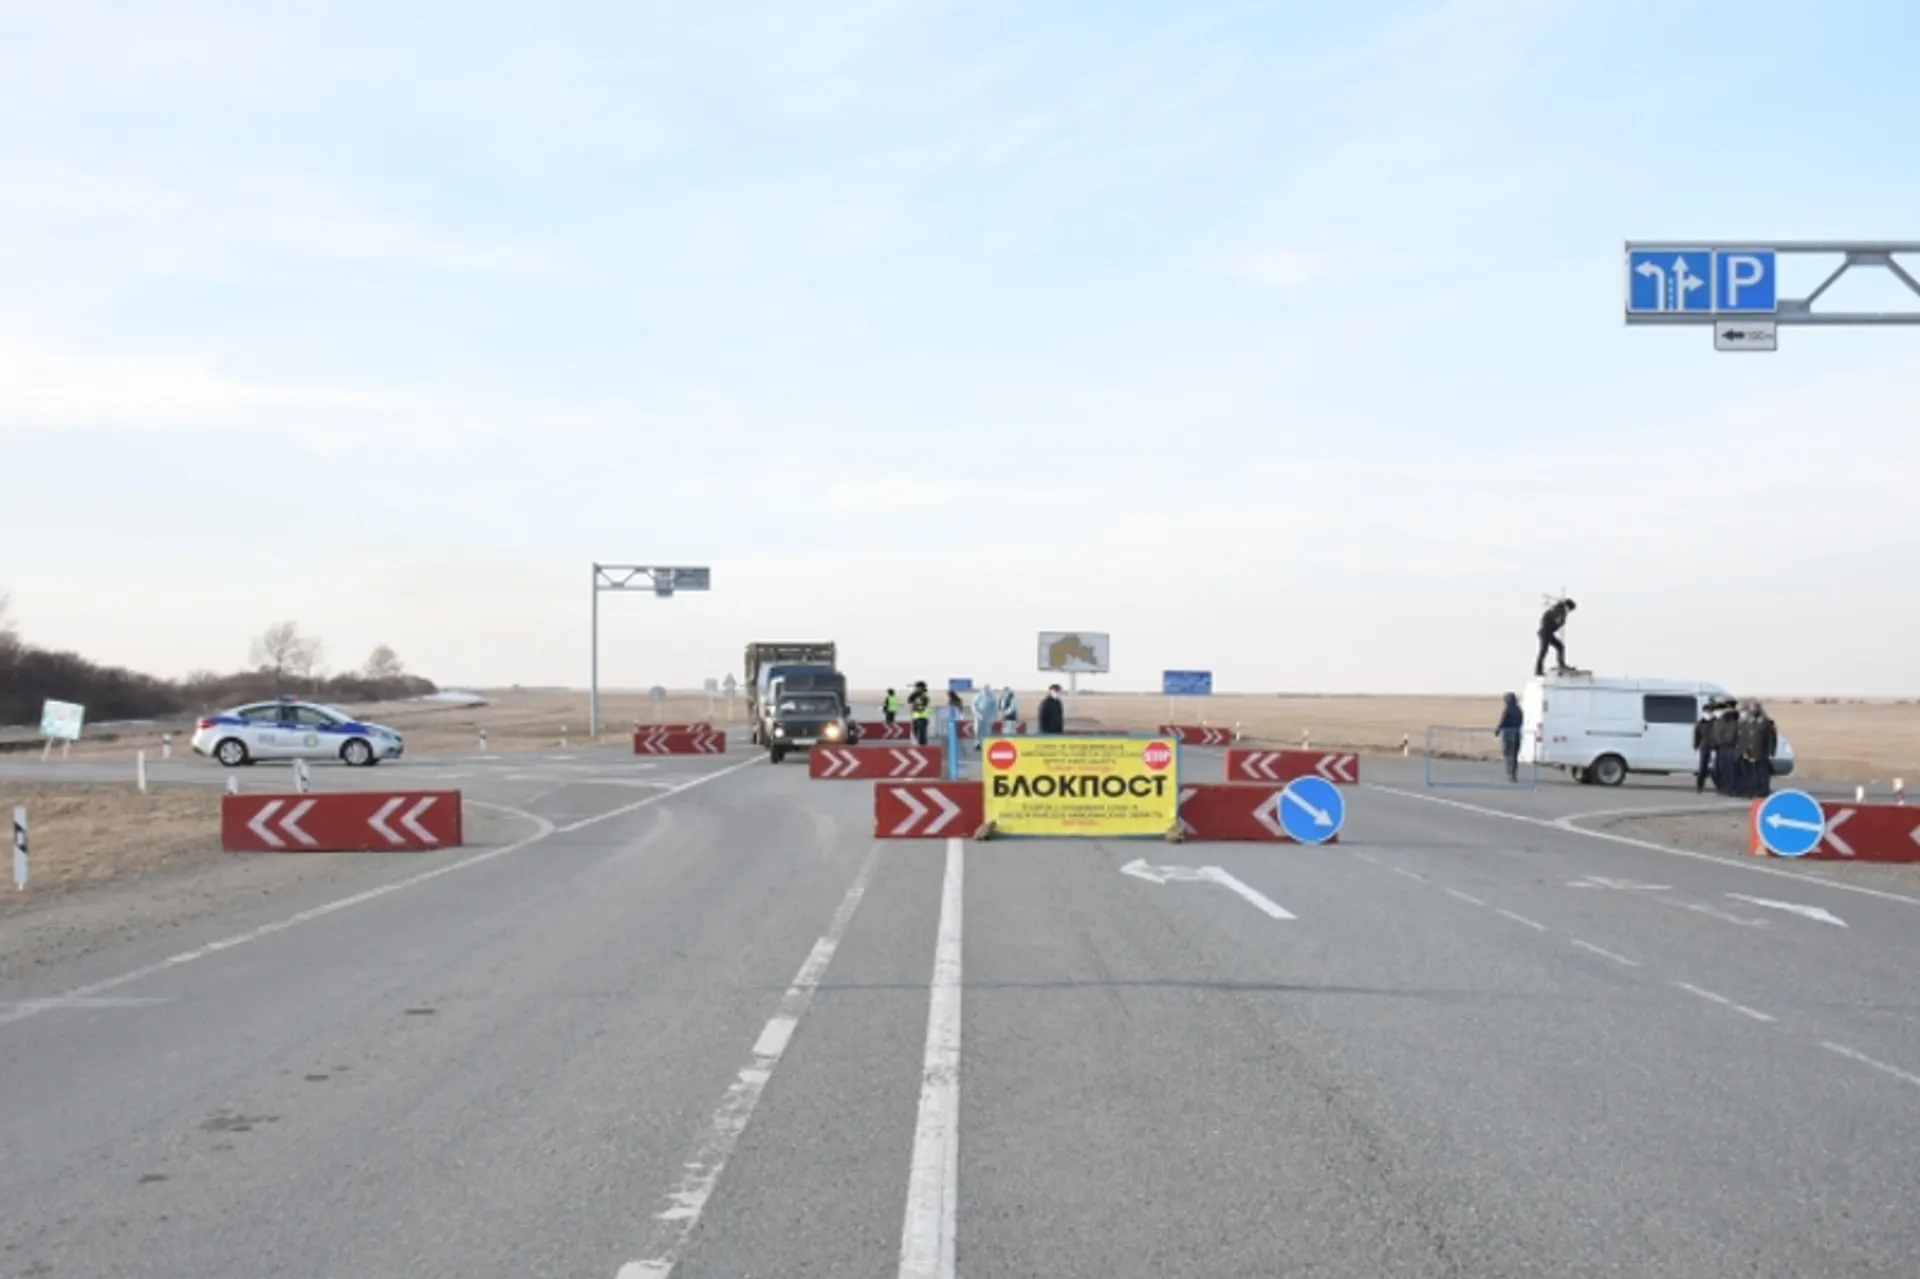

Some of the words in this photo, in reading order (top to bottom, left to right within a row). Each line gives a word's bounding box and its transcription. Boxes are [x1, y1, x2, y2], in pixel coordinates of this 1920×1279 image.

[1727, 256, 1764, 307] P
[1144, 750, 1170, 762] STOP
[993, 775, 1167, 797] БЛОКПОСТ
